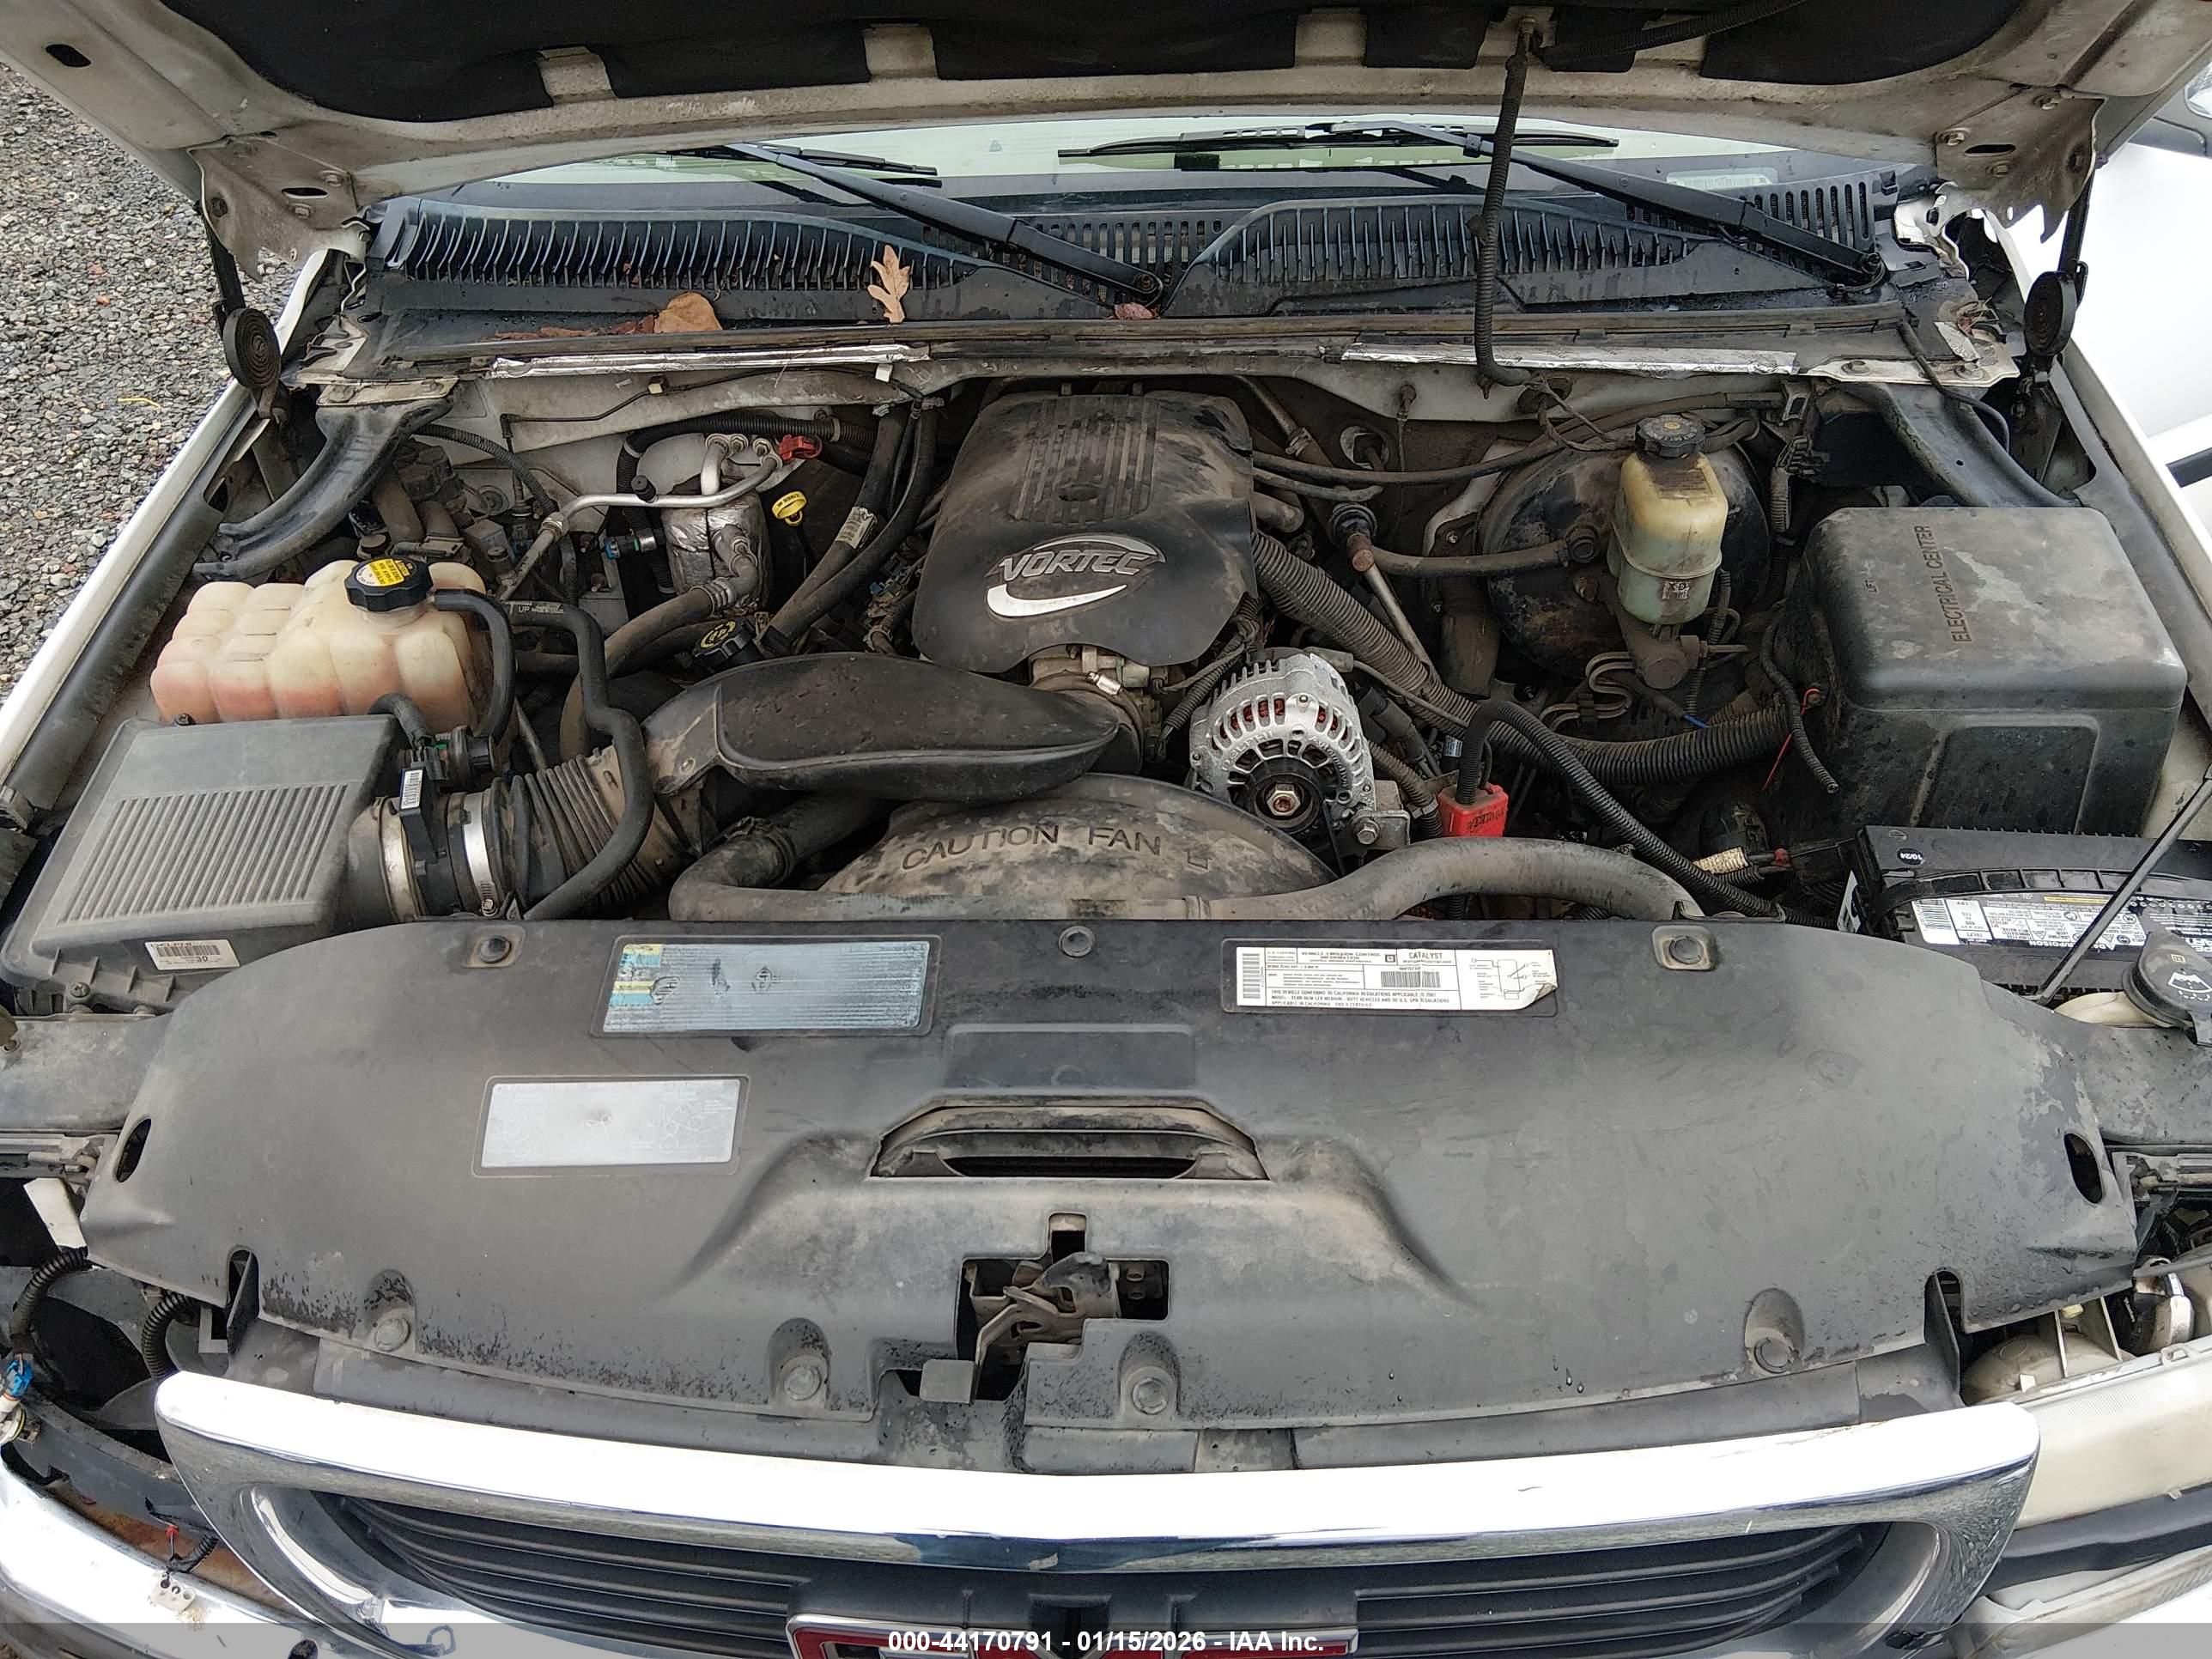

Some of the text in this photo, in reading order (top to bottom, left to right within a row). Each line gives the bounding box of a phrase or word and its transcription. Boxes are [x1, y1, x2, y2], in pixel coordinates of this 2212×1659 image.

[998, 549, 1152, 582] VORTEC
[1914, 525, 1972, 642] ELECTRICAL CENTER
[518, 605, 531, 614] UP
[901, 823, 1162, 872] CAUTION FAN
[1899, 852, 1923, 860] 10/24
[1408, 951, 1443, 960] CATALYST
